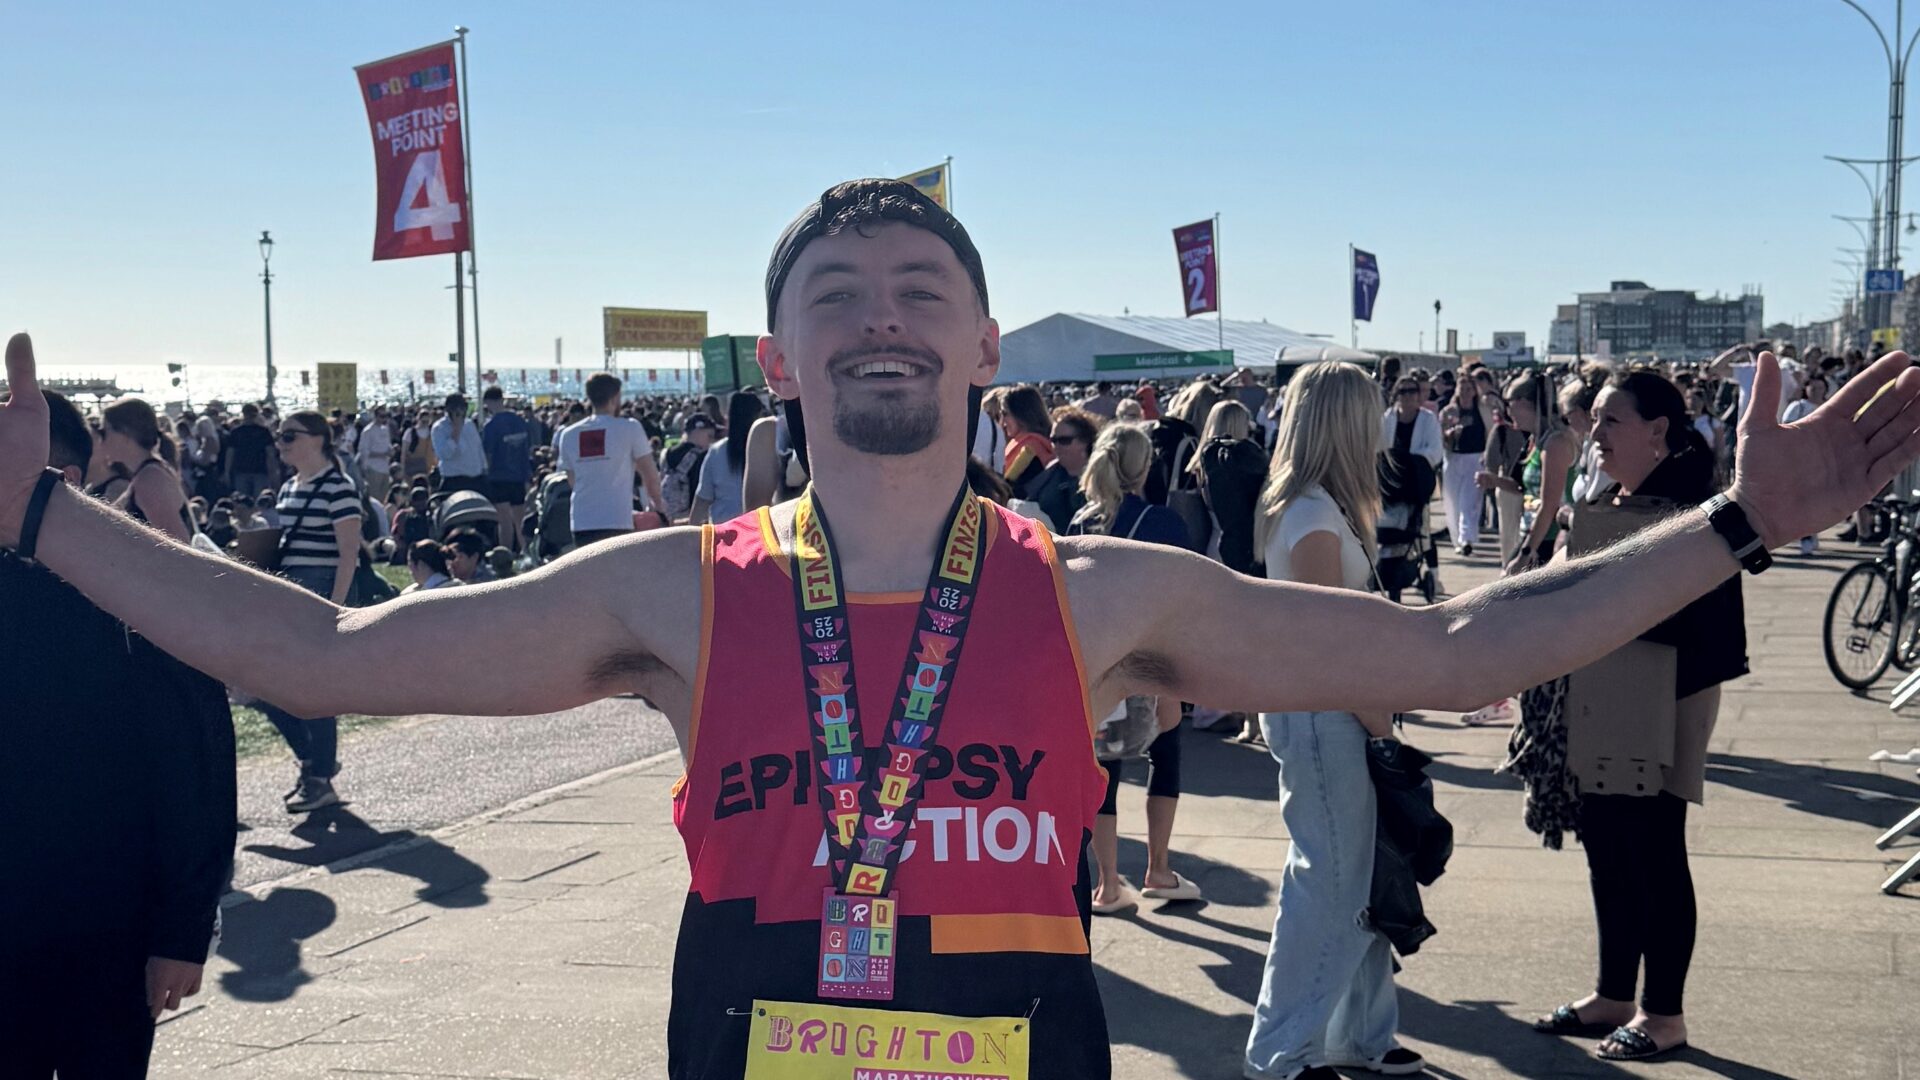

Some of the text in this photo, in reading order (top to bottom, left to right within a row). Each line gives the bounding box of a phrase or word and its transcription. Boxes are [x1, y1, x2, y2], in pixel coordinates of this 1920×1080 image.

[376, 102, 458, 140] MEETING
[391, 124, 447, 157] POINT
[394, 150, 461, 241] 4
[1188, 268, 1207, 311] 2
[1135, 355, 1178, 367] Medical
[714, 743, 1046, 820] EPIPSY
[812, 806, 1066, 866] TION
[766, 1015, 1008, 1065] BRIGHTON
